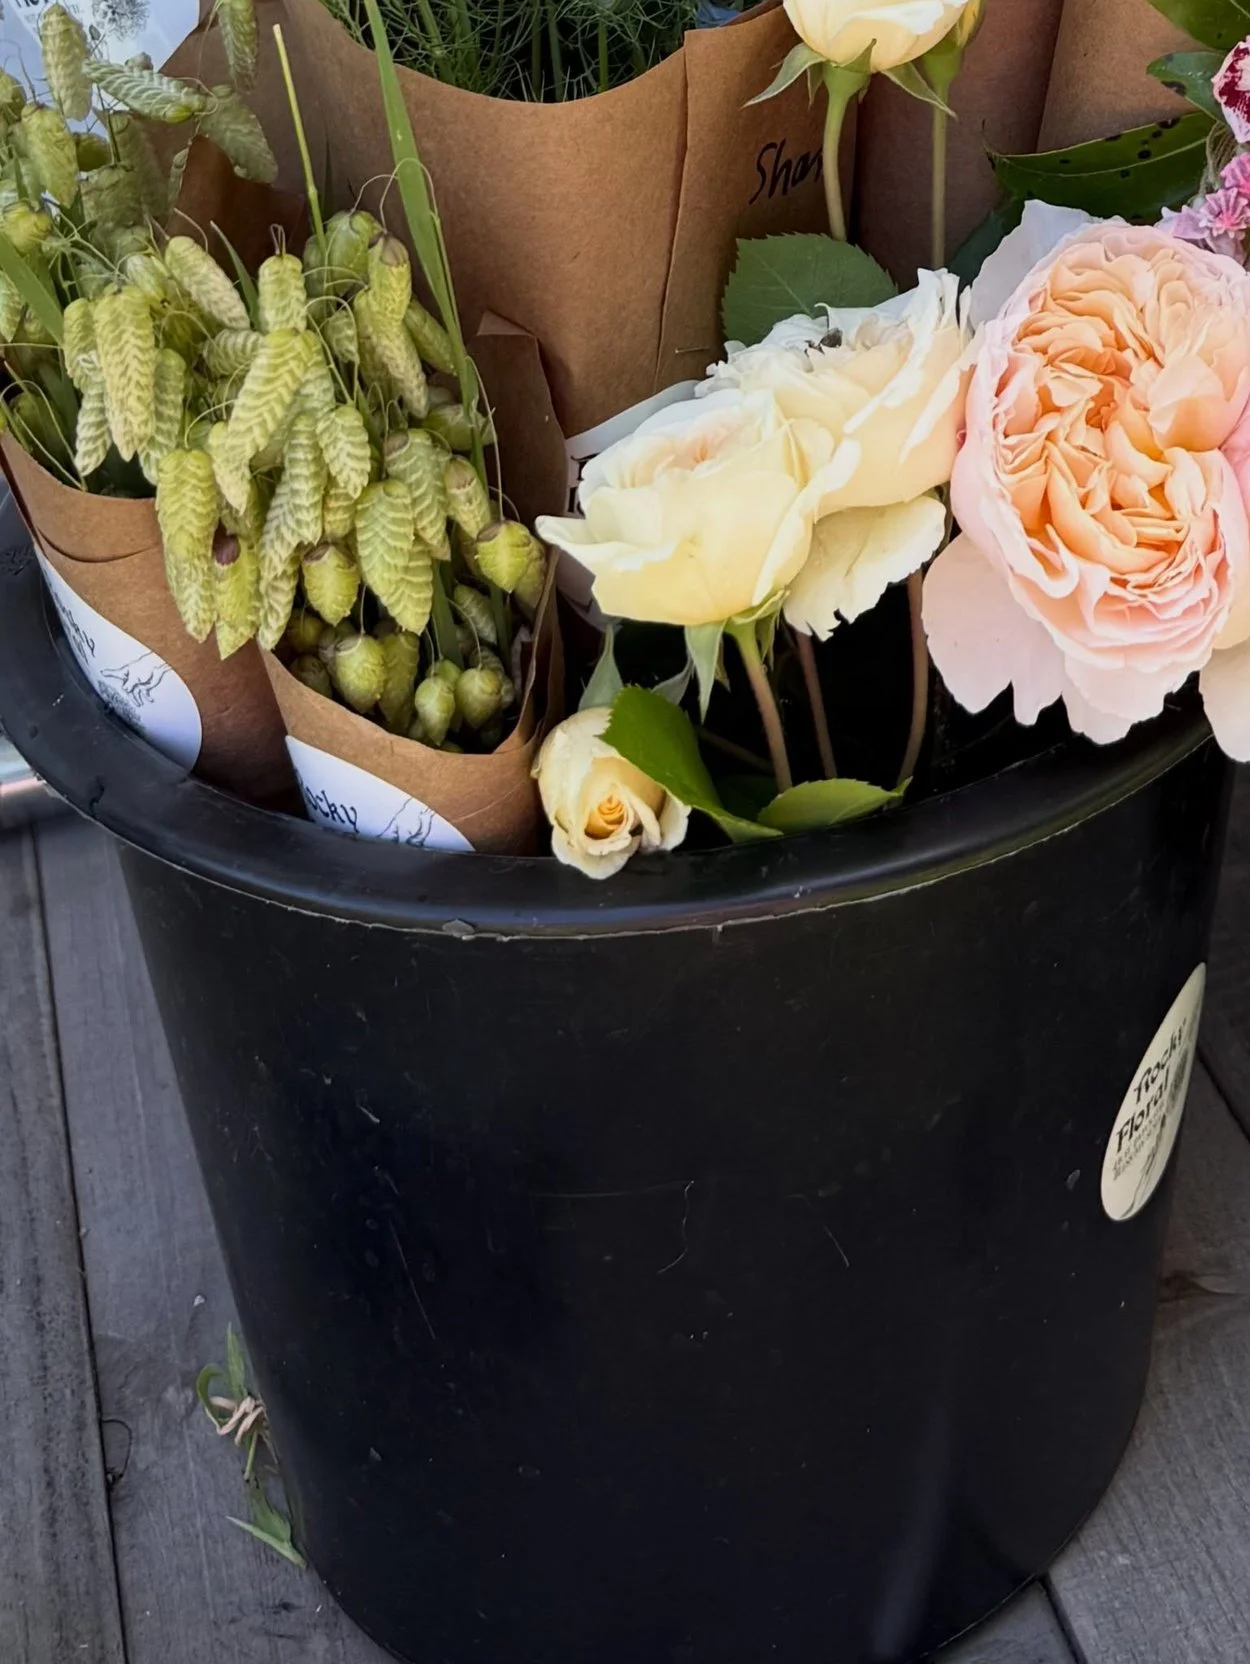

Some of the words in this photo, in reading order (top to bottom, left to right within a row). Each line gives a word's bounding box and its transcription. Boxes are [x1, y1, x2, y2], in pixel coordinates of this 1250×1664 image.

[302, 783, 361, 835] ocky
[1133, 1016, 1188, 1105] Rocky
[1115, 1064, 1171, 1154] Floral
